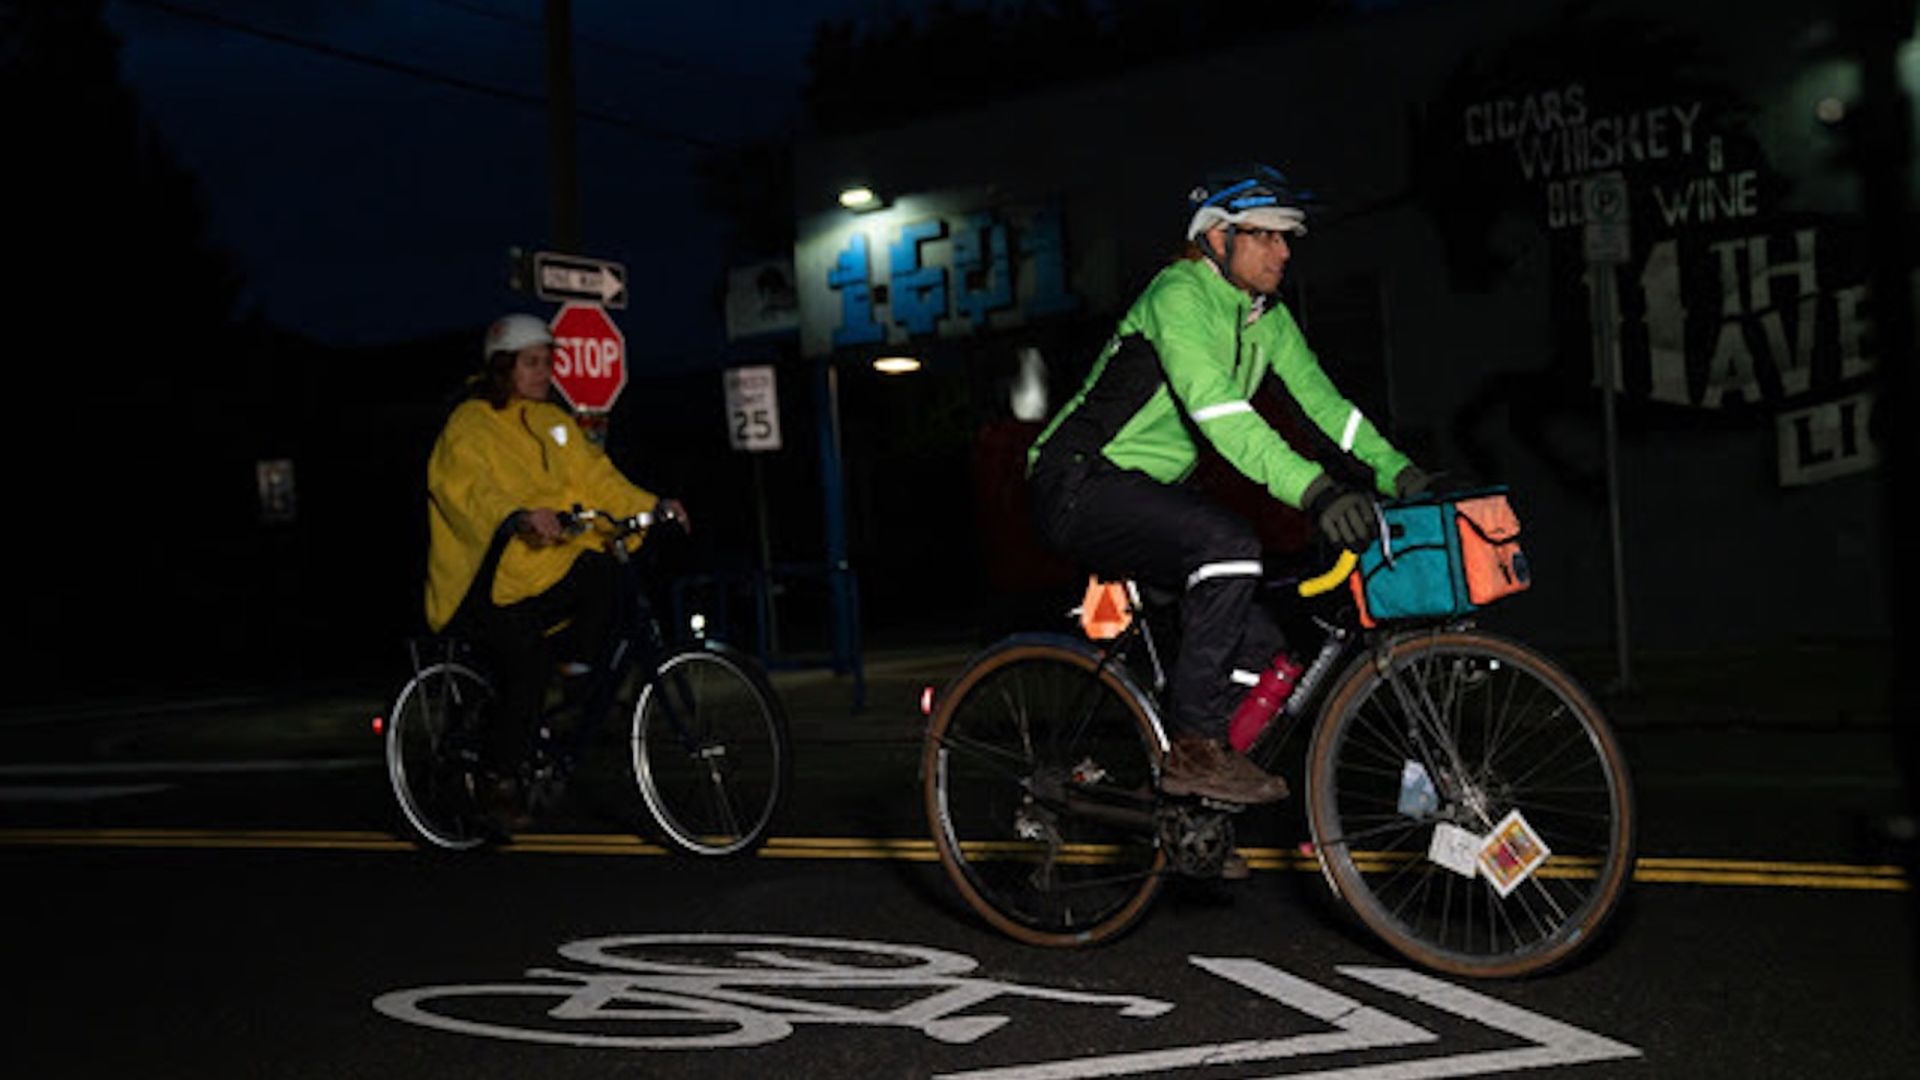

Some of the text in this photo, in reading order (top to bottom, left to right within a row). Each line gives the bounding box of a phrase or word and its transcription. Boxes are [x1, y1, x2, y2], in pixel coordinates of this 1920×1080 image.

[1464, 82, 1588, 147] CIGARS
[1516, 101, 1702, 181] WHISKEY
[1652, 169, 1758, 227] WINE
[828, 194, 1084, 347] 1601
[553, 337, 619, 379] STOP
[1700, 282, 1878, 410] AVE
[734, 411, 771, 439] 25
